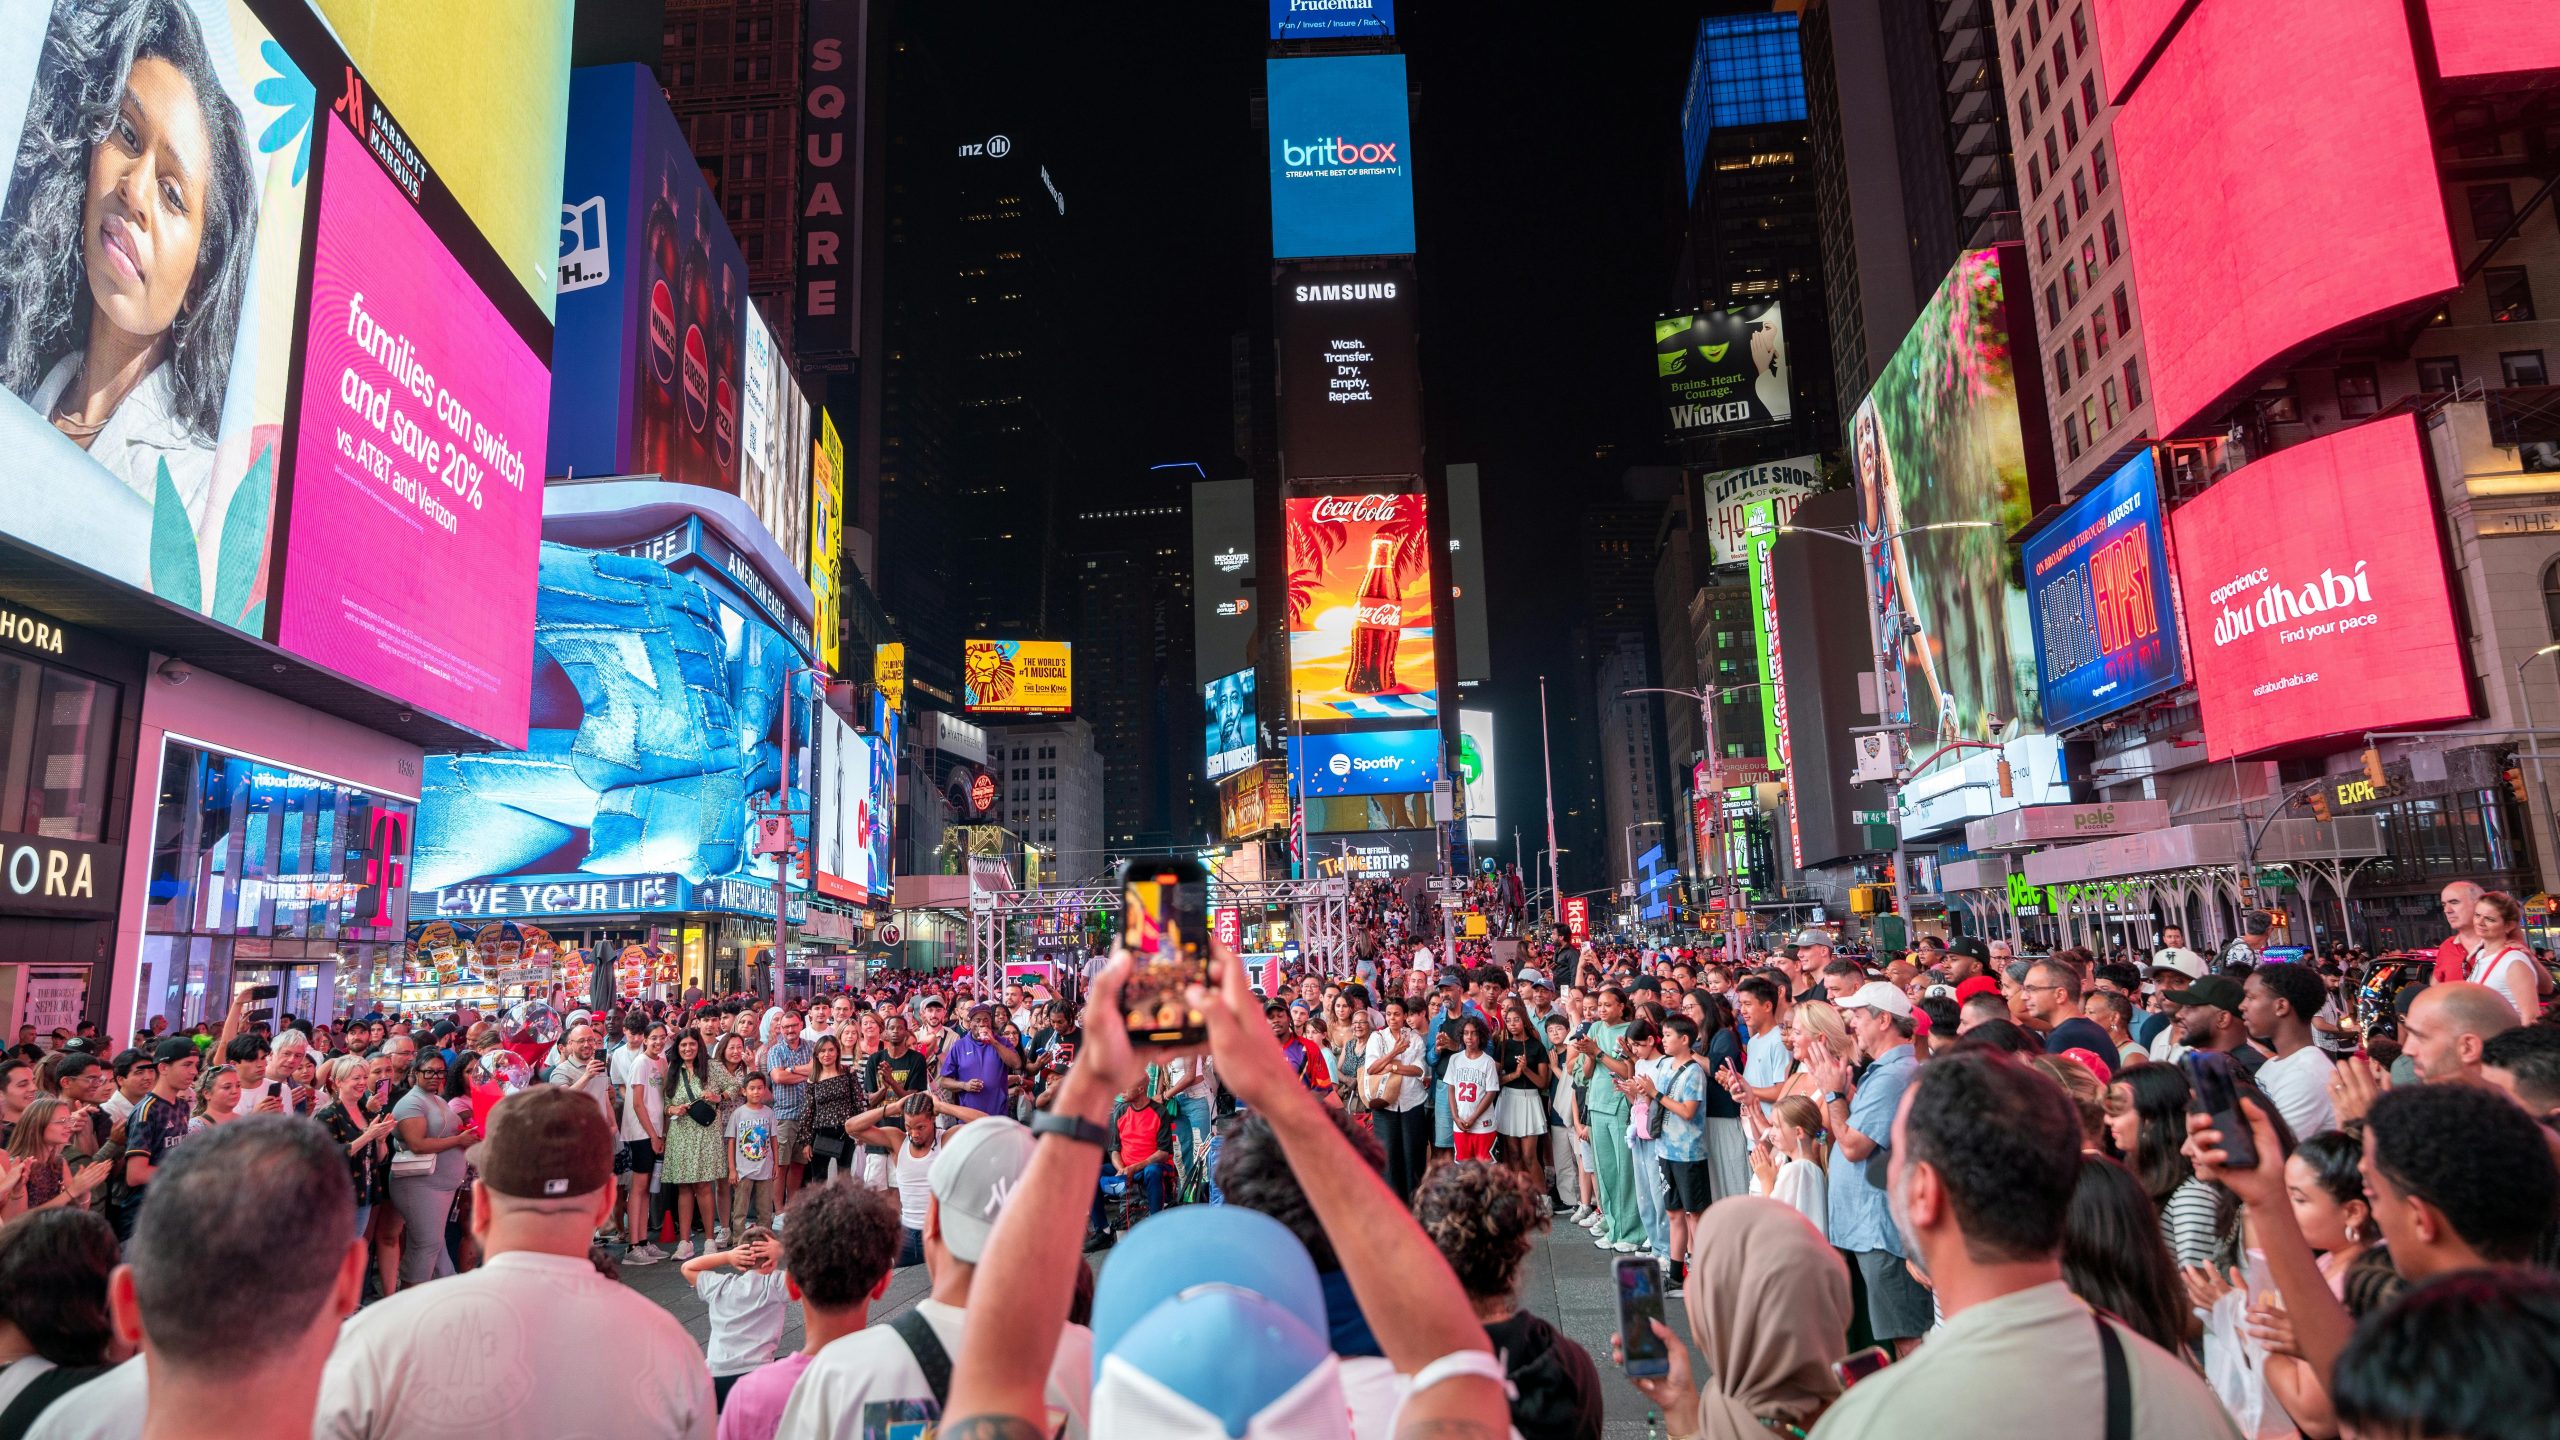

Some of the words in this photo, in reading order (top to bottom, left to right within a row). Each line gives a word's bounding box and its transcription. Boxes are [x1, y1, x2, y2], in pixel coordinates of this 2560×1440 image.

[1303, 21, 1326, 29] Invest
[1333, 20, 1356, 28] Insure
[373, 104, 427, 182] MARRIOTT
[1284, 136, 1397, 166] britbox
[369, 128, 419, 199] MARQUIS
[1286, 170, 1314, 178] STREAM
[1330, 169, 1347, 177] BEST
[1359, 168, 1386, 176] BRITISH
[1387, 167, 1396, 175] TV
[804, 38, 846, 316] SQUARE
[1296, 283, 1396, 302] SAMSUNG
[652, 308, 676, 355] WINGS
[1331, 339, 1365, 350] Wash.
[1324, 351, 1374, 363] Transfer.
[684, 351, 708, 405] BURGERS
[1338, 365, 1361, 378] Dry.
[1671, 378, 1710, 392] Brains.
[1711, 372, 1746, 387] Heart.
[348, 292, 435, 408] families
[437, 388, 472, 442] can
[473, 422, 526, 492] switch
[1330, 378, 1370, 391] Empty.
[1685, 386, 1733, 401] Courage.
[1329, 390, 1372, 404] Repeat.
[715, 404, 732, 440] PIZZA
[341, 367, 391, 433] and
[391, 409, 440, 473] save
[441, 442, 484, 510] 20%
[337, 427, 356, 460] vs.
[356, 438, 393, 484] AT&T
[392, 471, 417, 505] and
[418, 481, 457, 534] Verizon
[1716, 467, 1769, 504] LITTLE
[1771, 466, 1813, 488] SHOP
[1756, 488, 1767, 497] OF
[1312, 493, 1399, 524] Coca-Cola
[2036, 562, 2045, 576] ON
[2045, 543, 2077, 573] BROADWAY
[2076, 518, 2107, 549] THROUGH
[2107, 493, 2134, 528] AUGUST
[727, 552, 766, 607] AMERICAN
[766, 588, 786, 626] EAGLE
[2090, 523, 2158, 655] GYPSY
[2210, 567, 2269, 605] experience
[2214, 603, 2255, 647] abu
[2279, 627, 2305, 645] Find
[2306, 621, 2336, 641] your
[2339, 613, 2379, 633] pace
[1019, 667, 1029, 678] #1
[1030, 667, 1067, 678] MUSICAL
[1023, 657, 1035, 666] THE
[1037, 658, 1066, 667] WORLD'S
[2252, 672, 2319, 697] visitabudhabi.ae
[1353, 756, 1403, 772] Spotify
[1724, 763, 1749, 771] CIRQUE
[1740, 772, 1770, 784] LUZIA
[1870, 812, 1880, 823] 46
[1356, 847, 1366, 855] THE
[1367, 846, 1390, 855] OFFICIAL
[1358, 871, 1366, 879] OF
[436, 883, 509, 916] LIVE
[519, 884, 608, 913] YOUR
[618, 878, 667, 909] LIFE
[1221, 910, 1236, 944] tkts
[1568, 900, 1583, 933] tkts
[1038, 935, 1080, 946] KLIKTIX
[50, 987, 76, 998] BIGGEST
[34, 1000, 75, 1014] SEPHORA
[1458, 1081, 1478, 1103] 23
